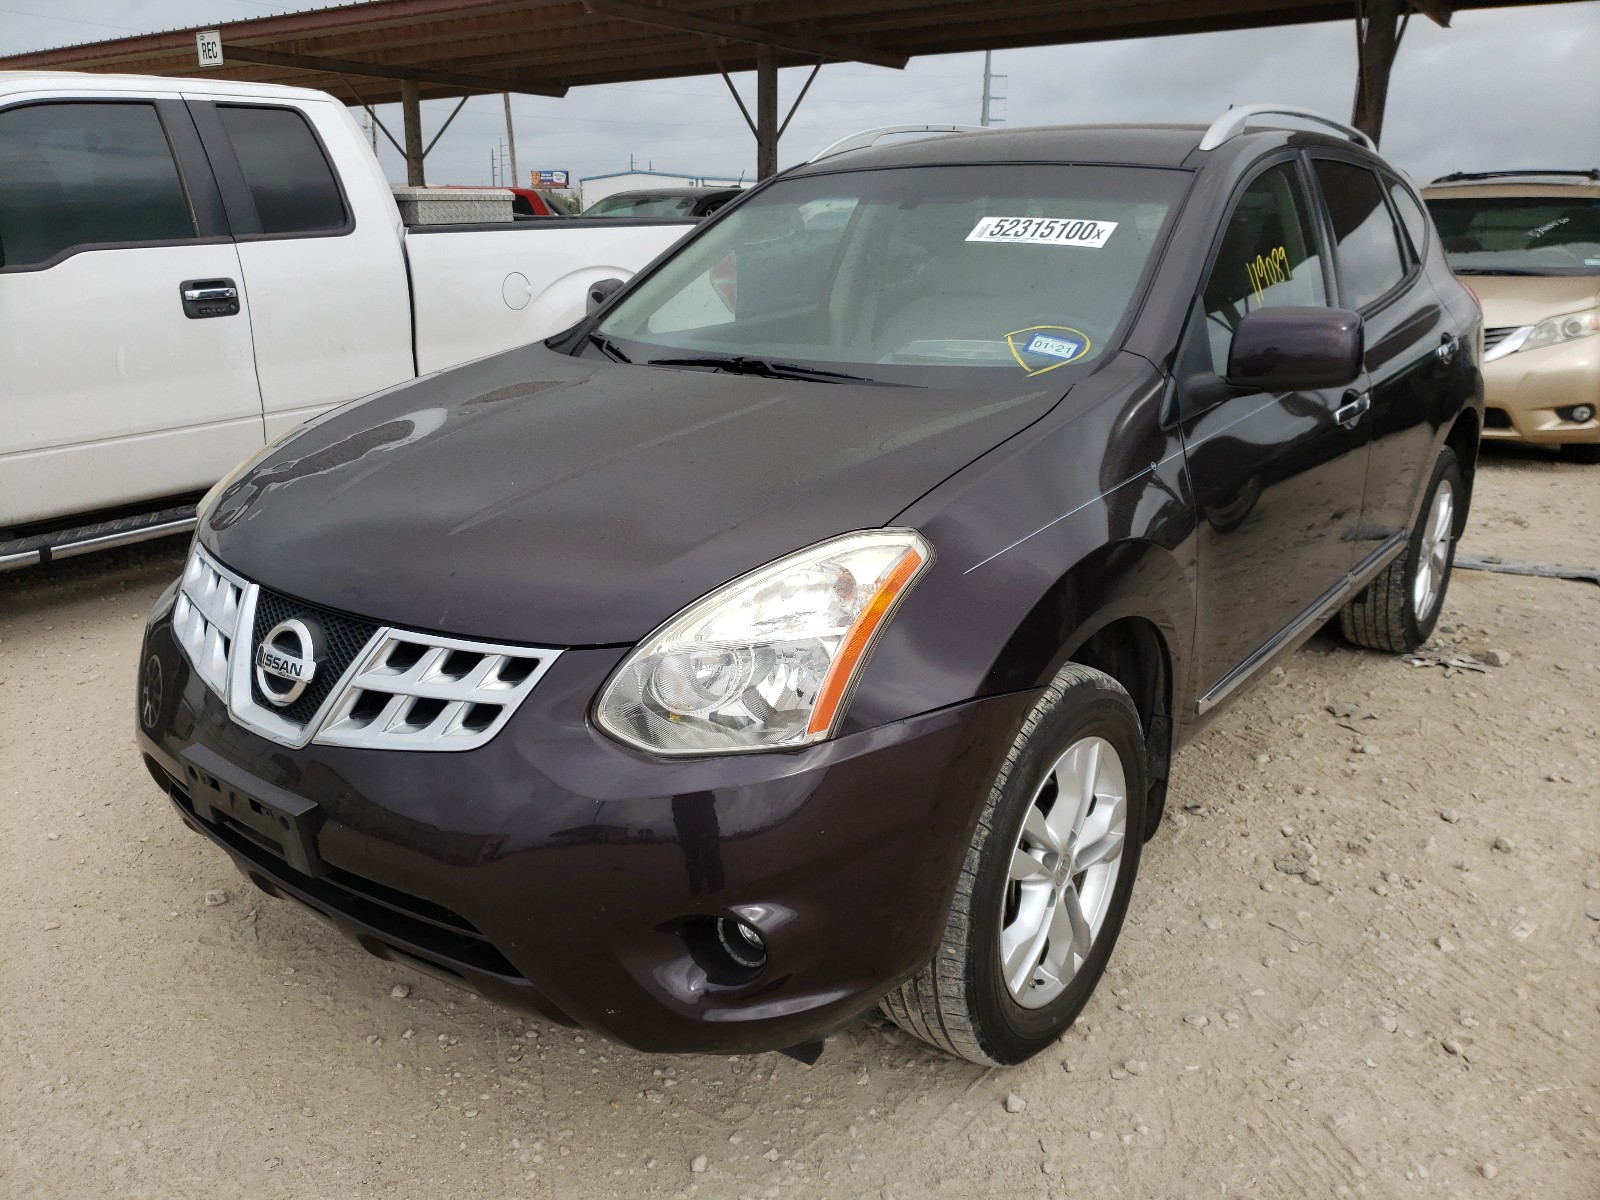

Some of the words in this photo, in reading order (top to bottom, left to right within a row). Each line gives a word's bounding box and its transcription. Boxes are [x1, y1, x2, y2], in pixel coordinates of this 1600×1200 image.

[201, 41, 218, 60] REC
[1245, 246, 1292, 308] 119089
[257, 645, 303, 677] NISSAN
